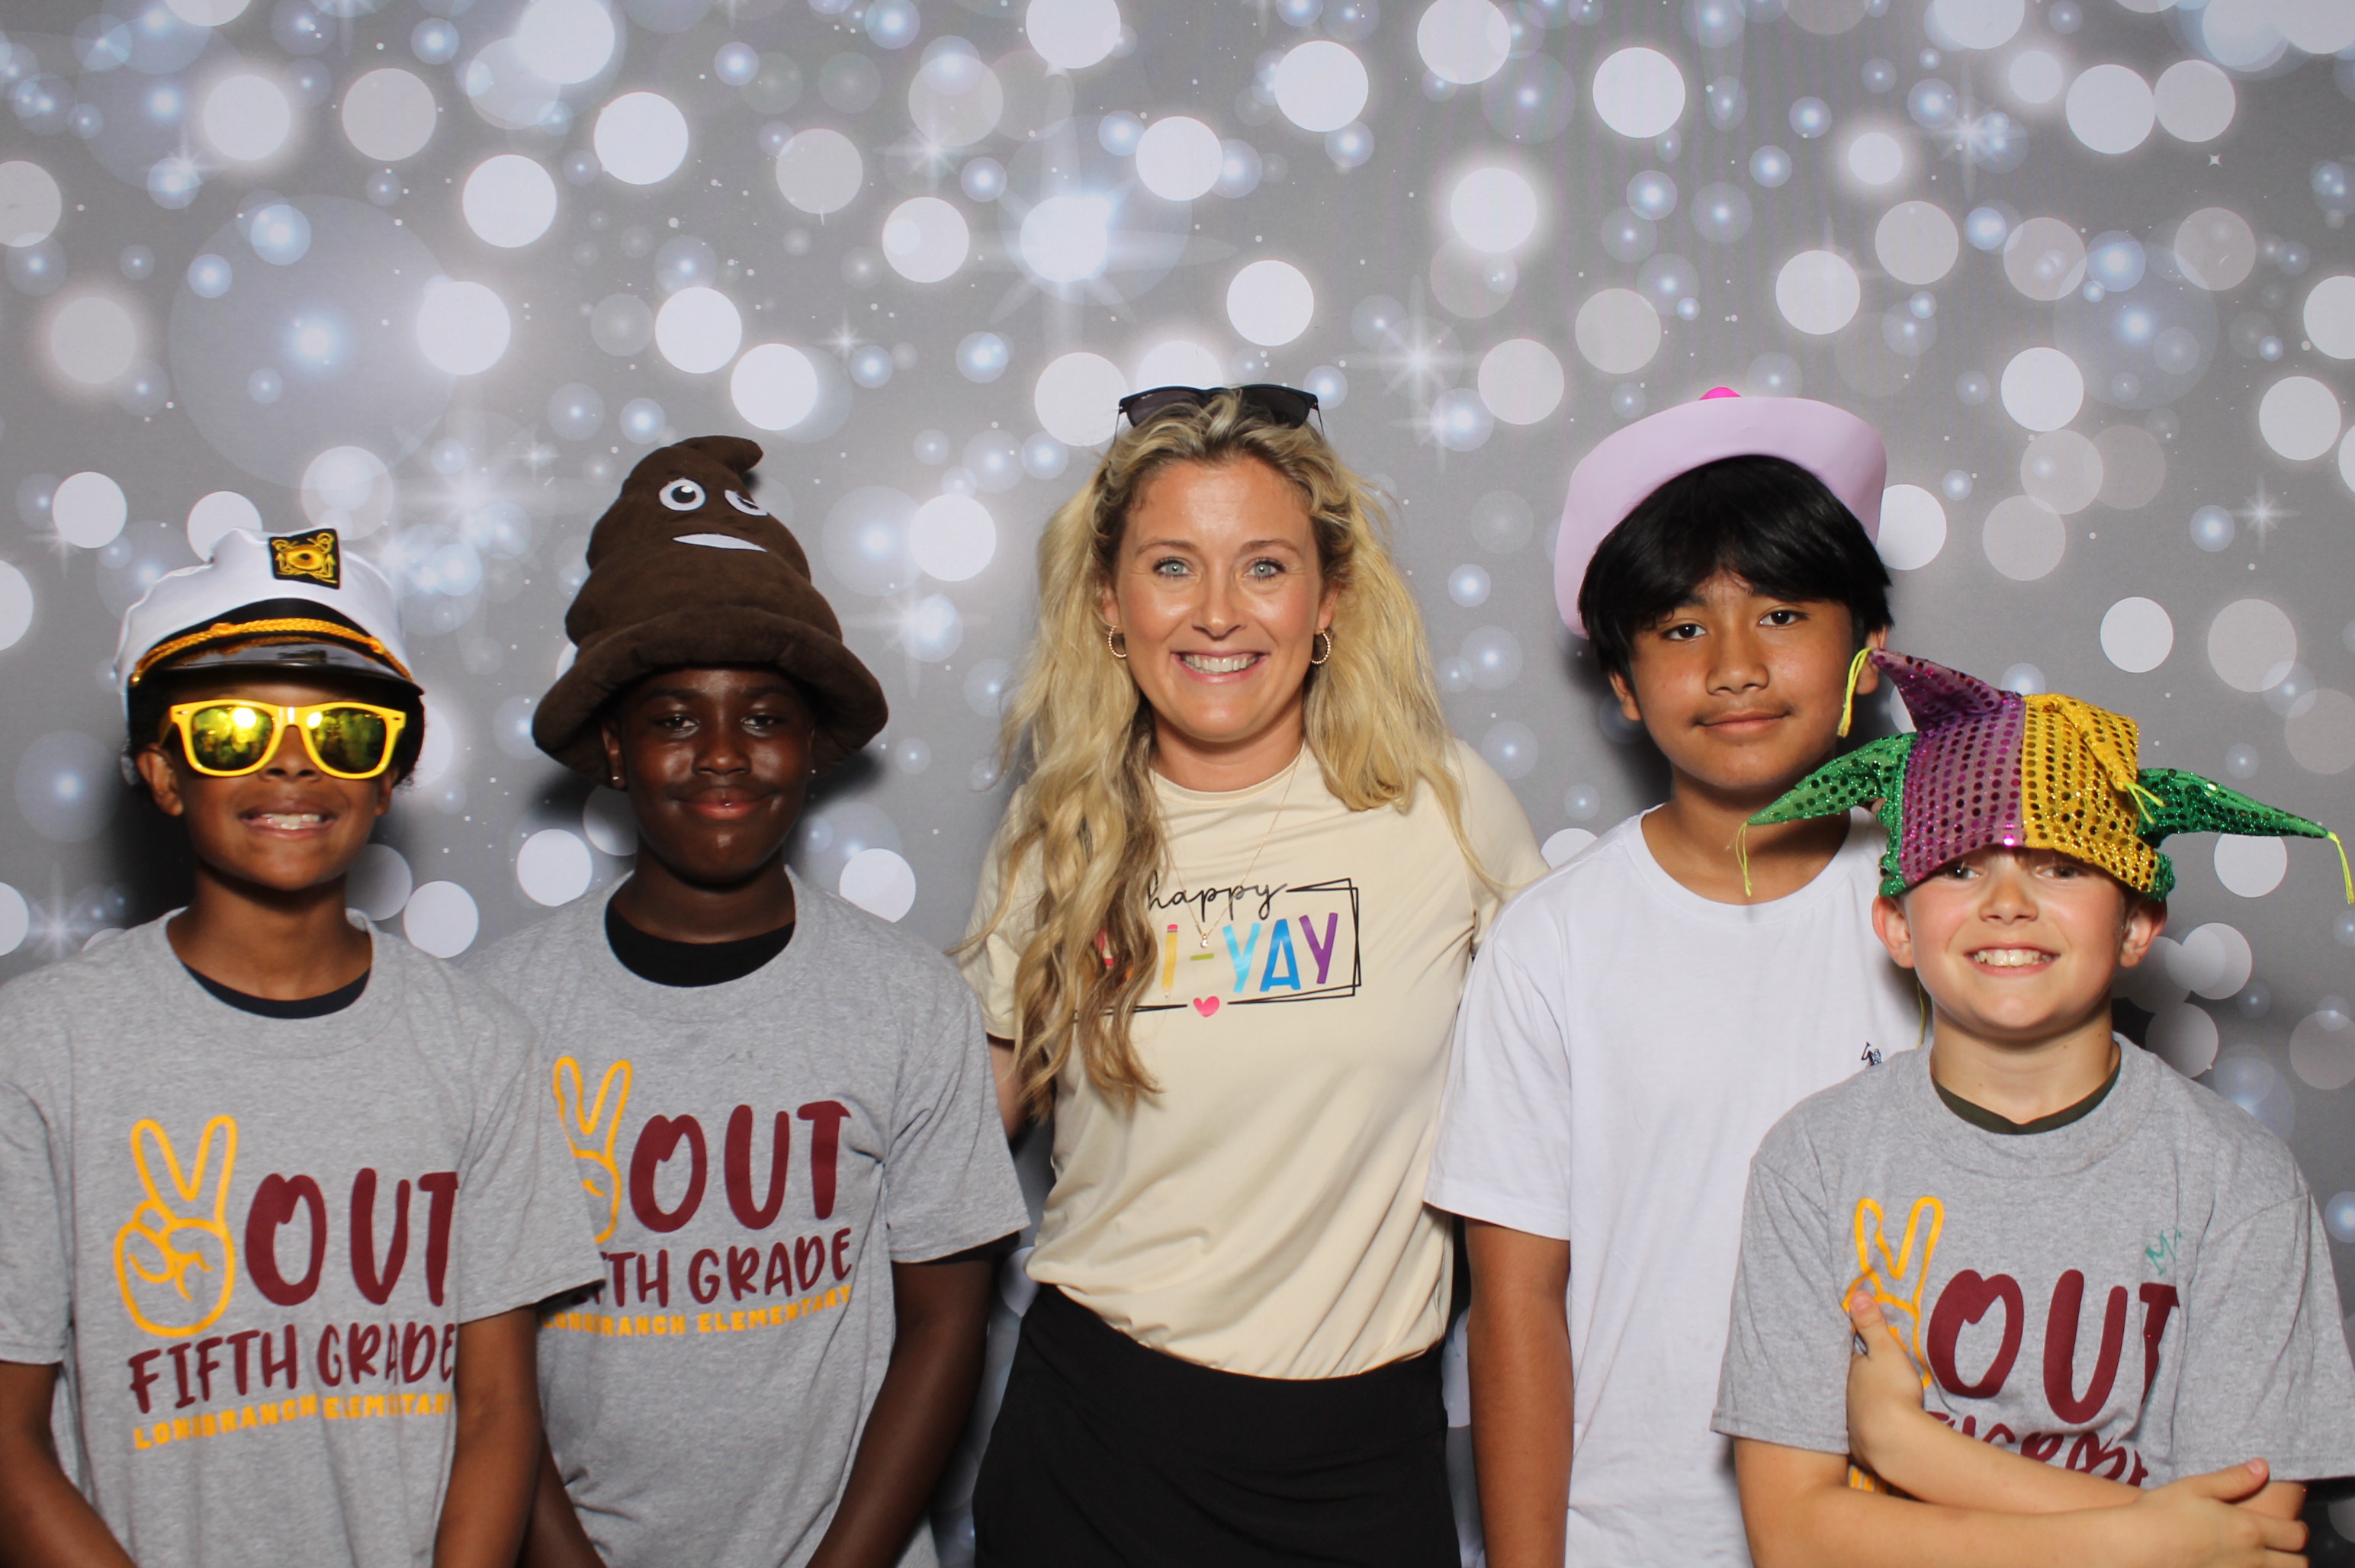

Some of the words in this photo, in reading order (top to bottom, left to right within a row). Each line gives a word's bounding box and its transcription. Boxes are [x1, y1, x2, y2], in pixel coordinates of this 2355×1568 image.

[1147, 871, 1287, 922] happy
[629, 1100, 852, 1233] OUT
[244, 1168, 458, 1307] OUT
[688, 1227, 852, 1304] GRADE
[697, 1284, 852, 1333] ELEMENTARY
[1926, 1269, 2180, 1424] OUT
[128, 1323, 299, 1414] FIFTH
[317, 1322, 455, 1387] GRADE
